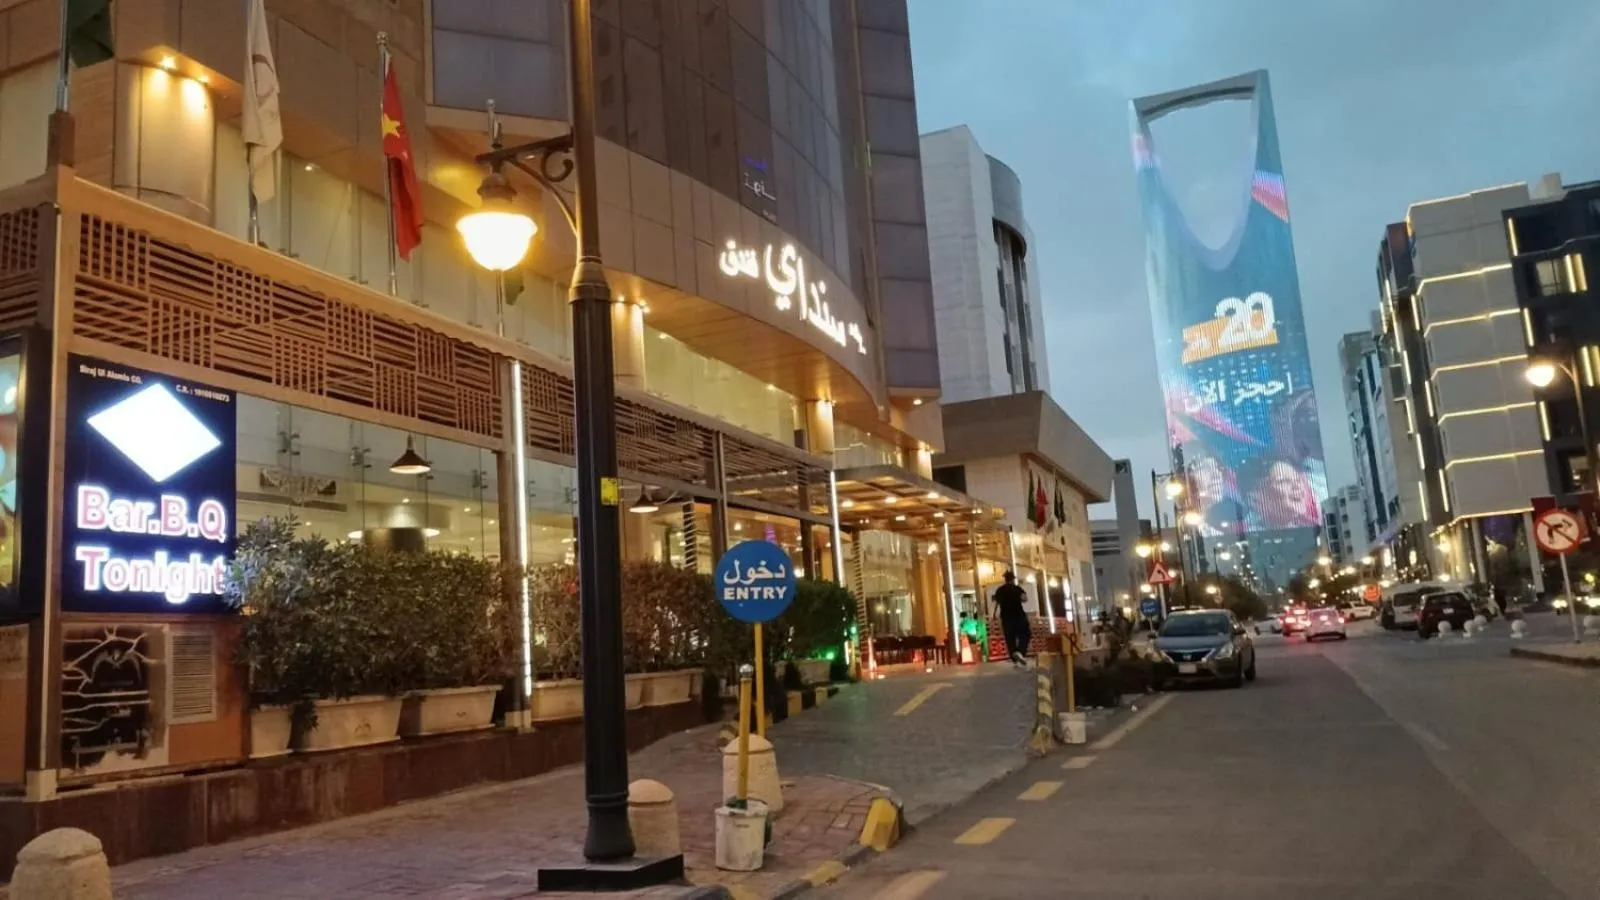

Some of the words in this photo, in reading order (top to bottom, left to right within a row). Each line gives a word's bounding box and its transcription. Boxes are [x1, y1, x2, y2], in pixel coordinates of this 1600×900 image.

[76, 485, 227, 543] Bar.B.Q
[75, 546, 227, 604] Tonight
[723, 559, 786, 585] دخول
[723, 586, 787, 600] ENTRY
